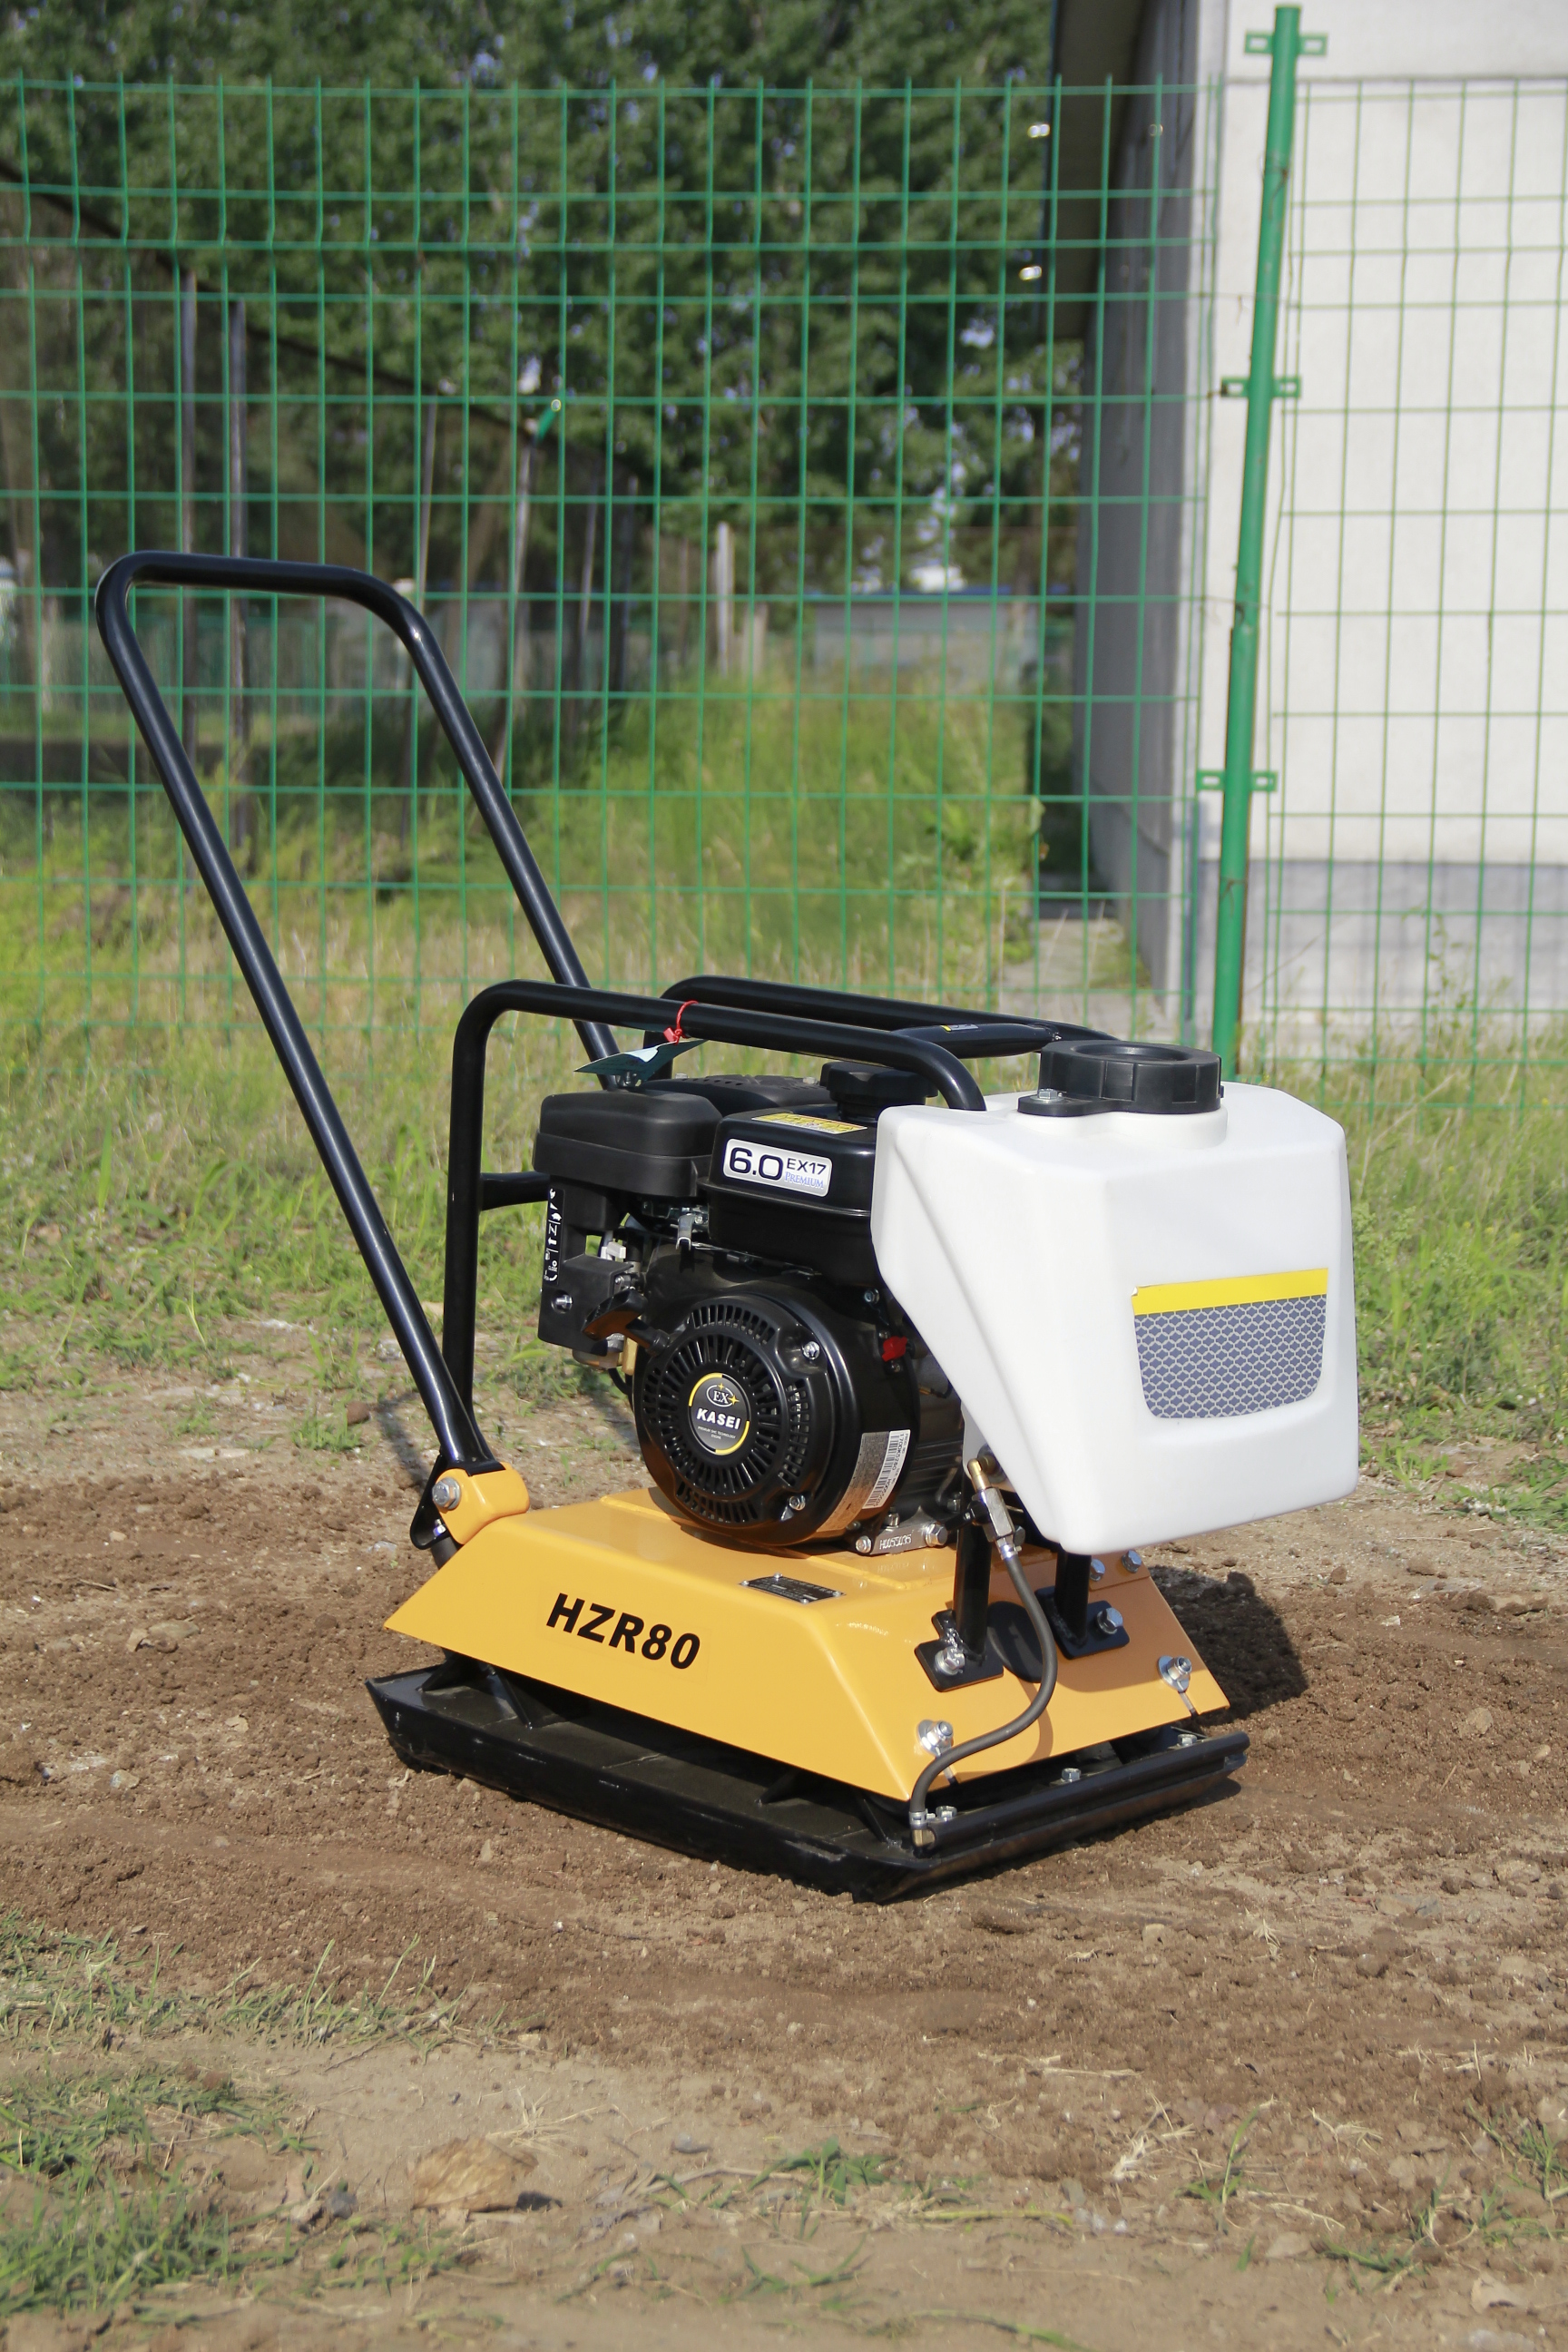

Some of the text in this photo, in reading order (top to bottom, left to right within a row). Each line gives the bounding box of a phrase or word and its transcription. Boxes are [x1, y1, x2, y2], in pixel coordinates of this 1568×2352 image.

[730, 1147, 783, 1181] 6.0
[787, 1158, 827, 1175] EX17
[784, 1171, 824, 1189] PREMIUM
[712, 1390, 730, 1405] EX
[697, 1407, 741, 1429] KASEI
[546, 1592, 701, 1670] HZR80
